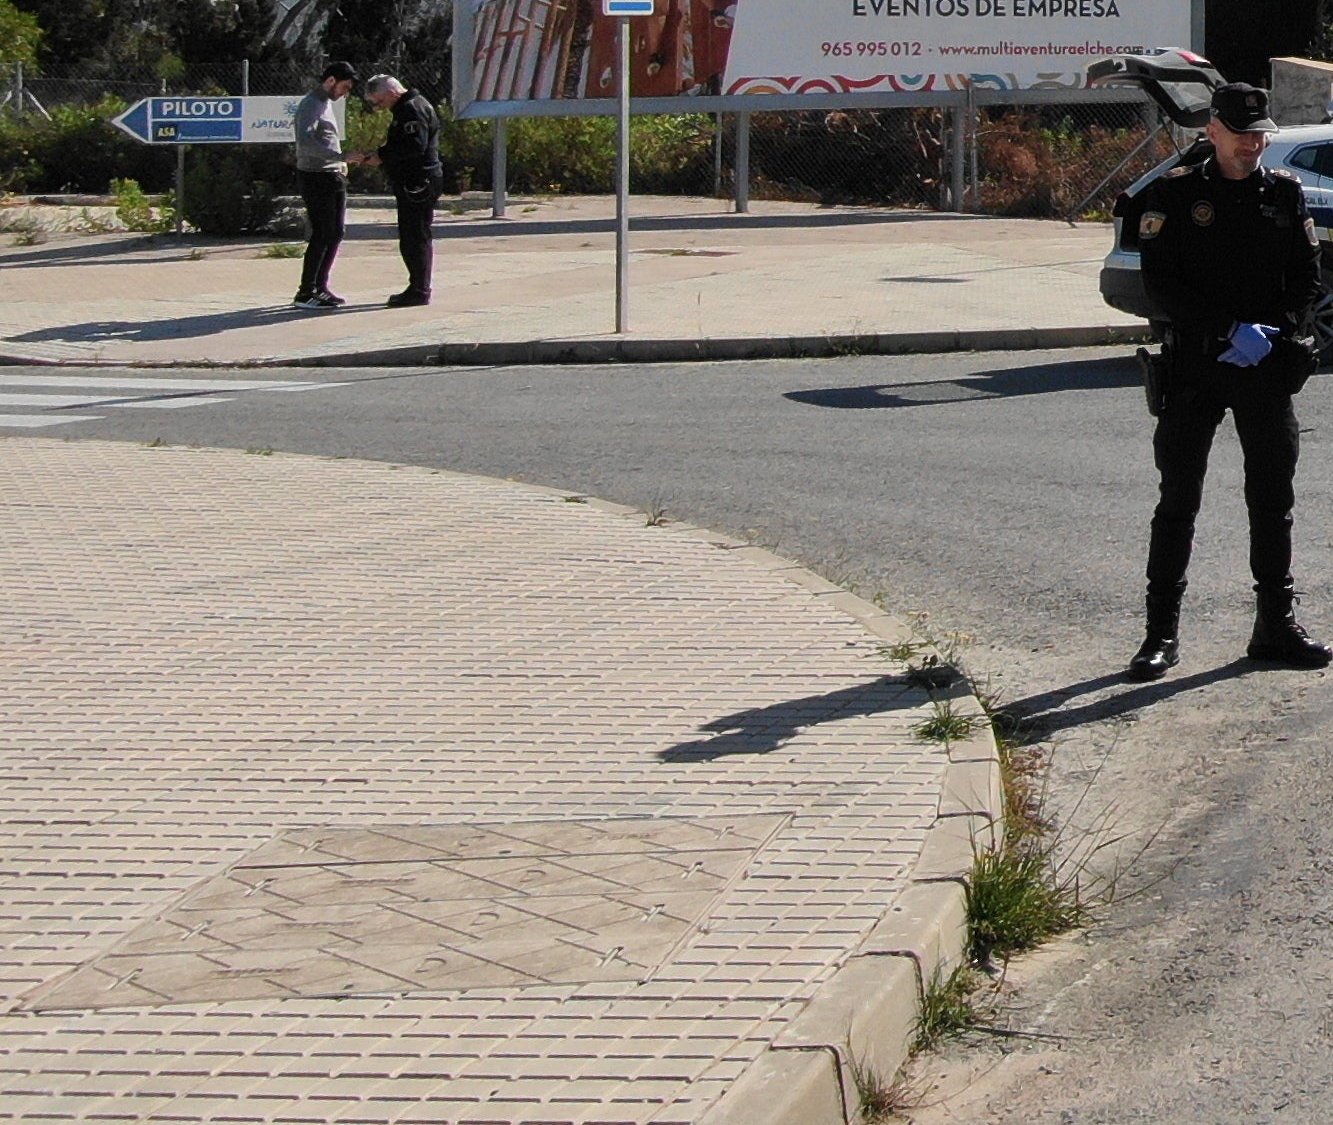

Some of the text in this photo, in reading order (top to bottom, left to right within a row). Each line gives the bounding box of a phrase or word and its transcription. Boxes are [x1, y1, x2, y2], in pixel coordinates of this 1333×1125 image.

[821, 41, 852, 57] 965
[856, 41, 887, 57] 995
[891, 41, 922, 57] 012
[162, 101, 234, 116] PILOTO
[157, 127, 175, 138] ASA
